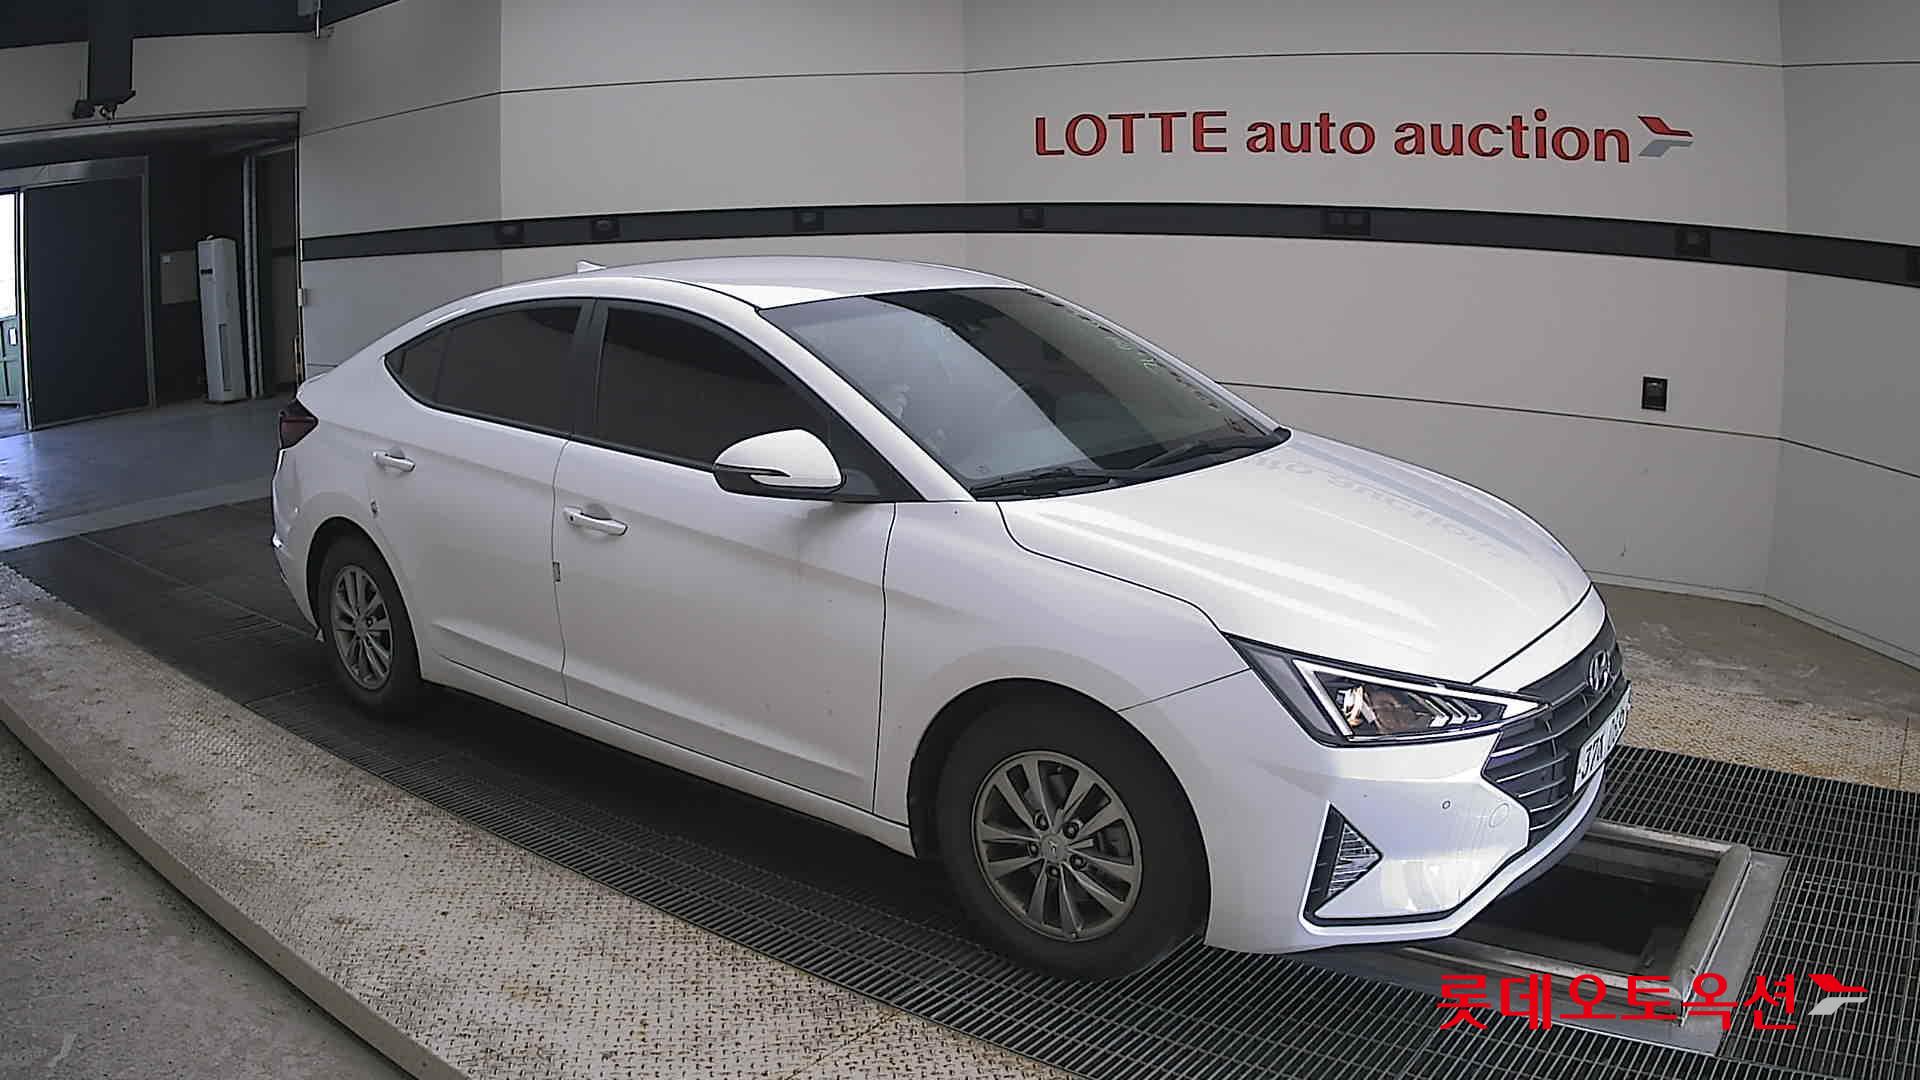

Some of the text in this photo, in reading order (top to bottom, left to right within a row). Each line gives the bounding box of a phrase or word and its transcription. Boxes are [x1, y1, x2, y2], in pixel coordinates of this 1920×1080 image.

[1034, 108, 1631, 163] LOTTE auto auction
